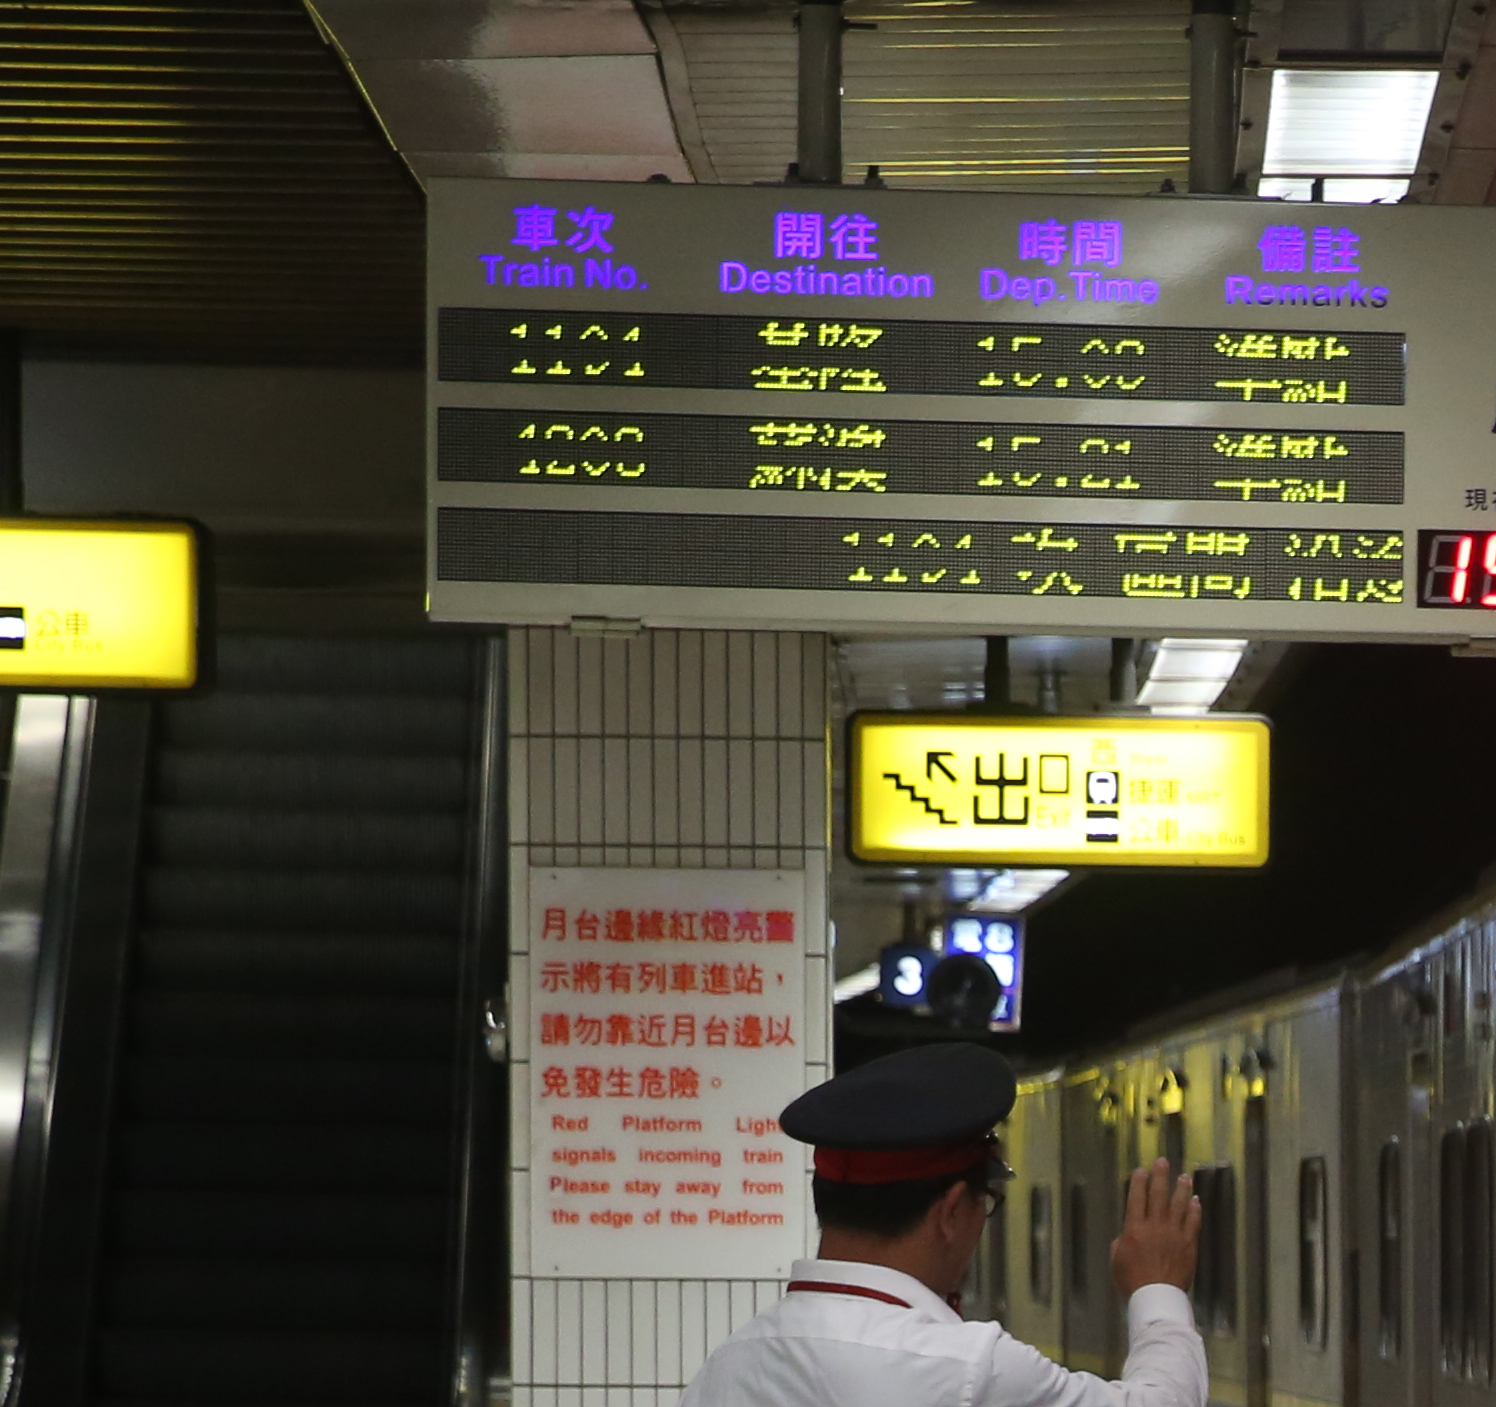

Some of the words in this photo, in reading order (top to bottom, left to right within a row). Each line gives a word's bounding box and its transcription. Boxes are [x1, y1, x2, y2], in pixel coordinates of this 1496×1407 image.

[510, 203, 615, 253] 車次
[773, 208, 880, 261] 開往
[1018, 219, 1123, 266] 時間
[1257, 225, 1361, 272] 備註
[478, 254, 574, 289] Train
[583, 257, 649, 290] No.
[718, 262, 935, 299] Destination
[1225, 276, 1390, 309] Remarks
[36, 610, 91, 637] 公車
[974, 753, 1069, 825] 出口
[1129, 779, 1180, 804] 捷運
[1036, 806, 1070, 827] Exit
[1130, 816, 1180, 843] 公車
[1217, 831, 1245, 845] Bus
[894, 956, 922, 995] 3
[541, 1013, 795, 1048] 請勿靠近月台邊以
[552, 1115, 588, 1132] Red
[622, 1115, 702, 1133] Platform
[552, 1148, 616, 1167] signals
[639, 1149, 722, 1168] incoming
[744, 1150, 783, 1164] train
[550, 1177, 610, 1195] Please
[624, 1179, 661, 1198] stay
[676, 1181, 721, 1198] away
[743, 1179, 783, 1195] from
[552, 1209, 580, 1225] the
[589, 1209, 634, 1229] edge
[643, 1209, 661, 1225] of
[670, 1209, 698, 1225] the
[708, 1208, 784, 1226] Platform
